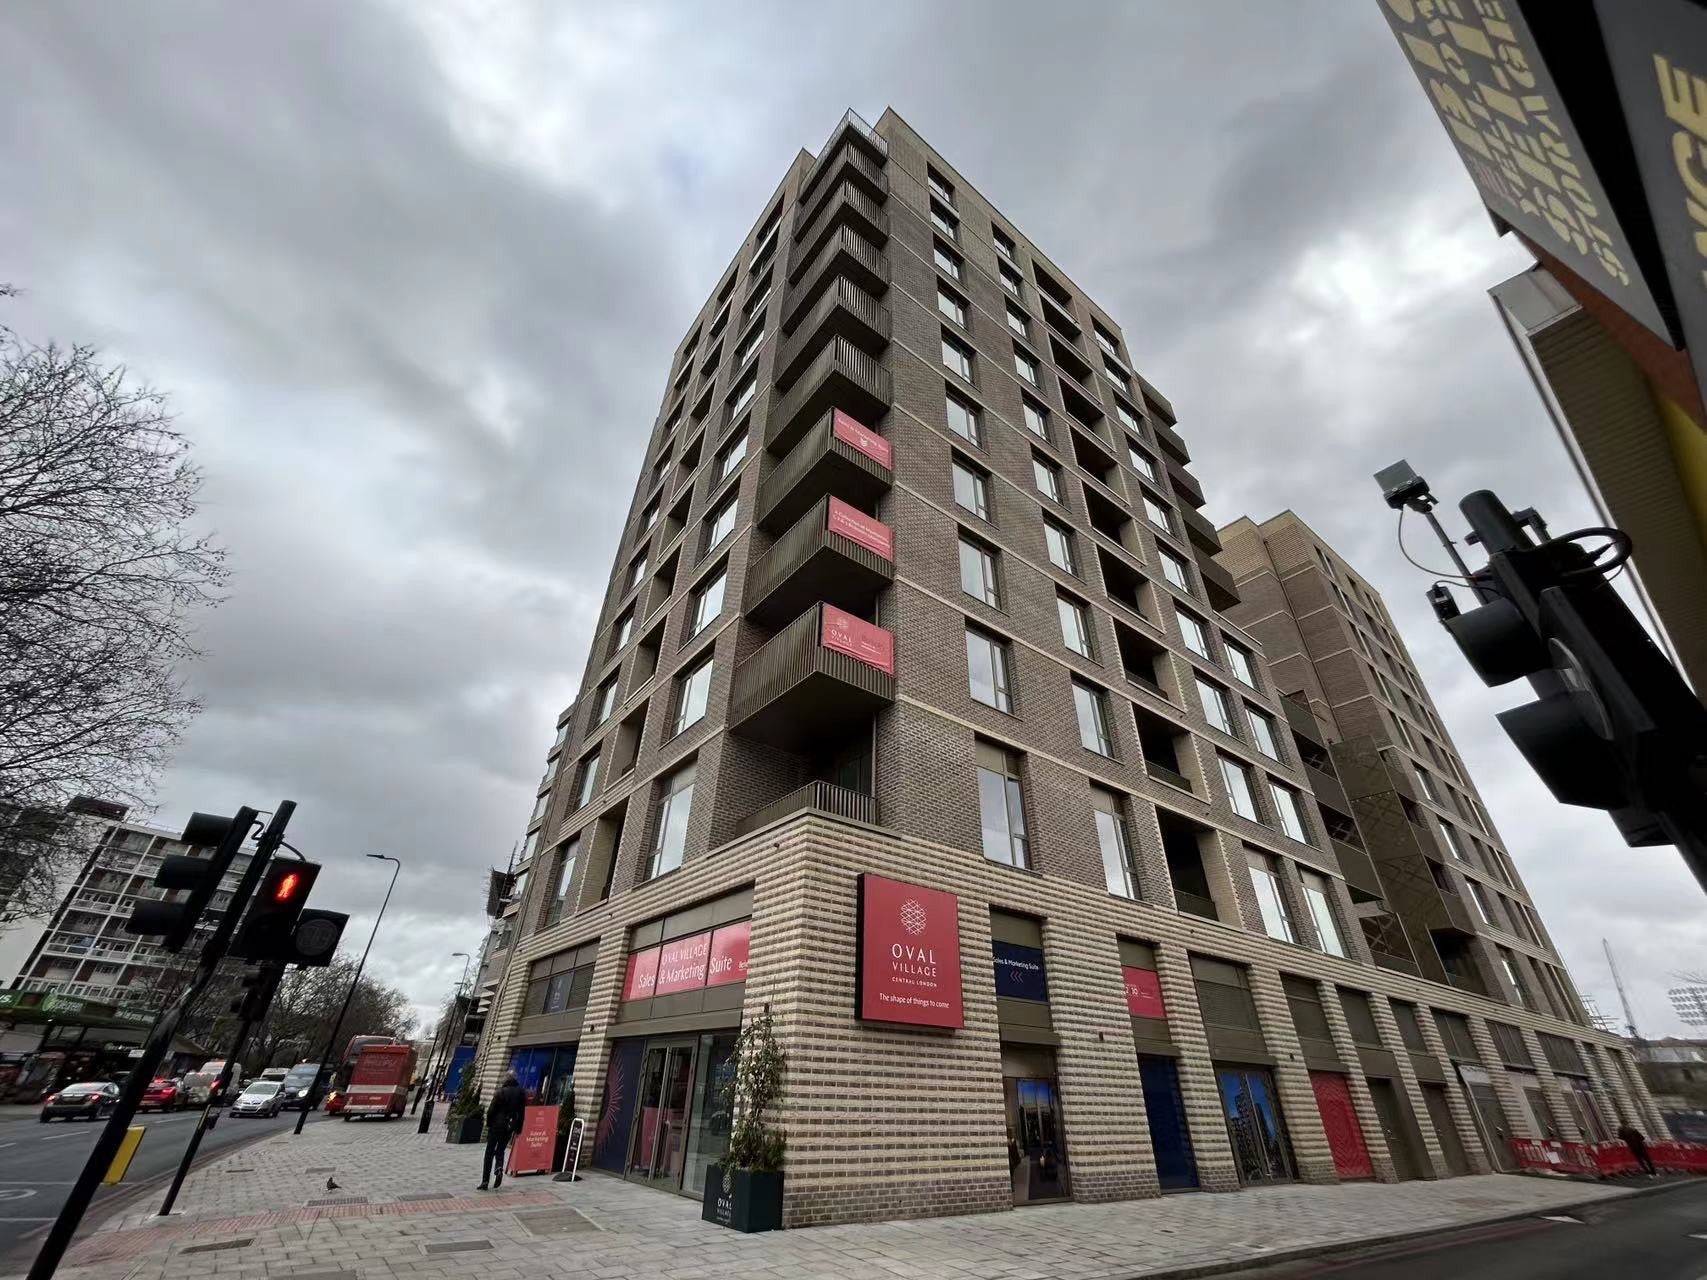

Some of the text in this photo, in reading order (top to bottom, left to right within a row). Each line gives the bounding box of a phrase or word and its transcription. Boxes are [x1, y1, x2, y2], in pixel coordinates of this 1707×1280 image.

[831, 629, 852, 643] OVAL
[662, 943, 708, 966] OVAL VILLAGE
[892, 943, 936, 965] OVAL
[638, 956, 733, 989] Sales & Marketing Suite
[892, 961, 937, 977] VILLAGE
[1008, 959, 1029, 970] Marketing
[1029, 962, 1039, 970] Suite
[892, 976, 937, 988] CENTRAL LONDON
[880, 992, 890, 1002] The
[890, 994, 906, 1004] shape
[907, 996, 912, 1004] of
[913, 996, 929, 1008] things
[936, 1001, 950, 1009] come
[717, 1197, 732, 1209] OVAL
